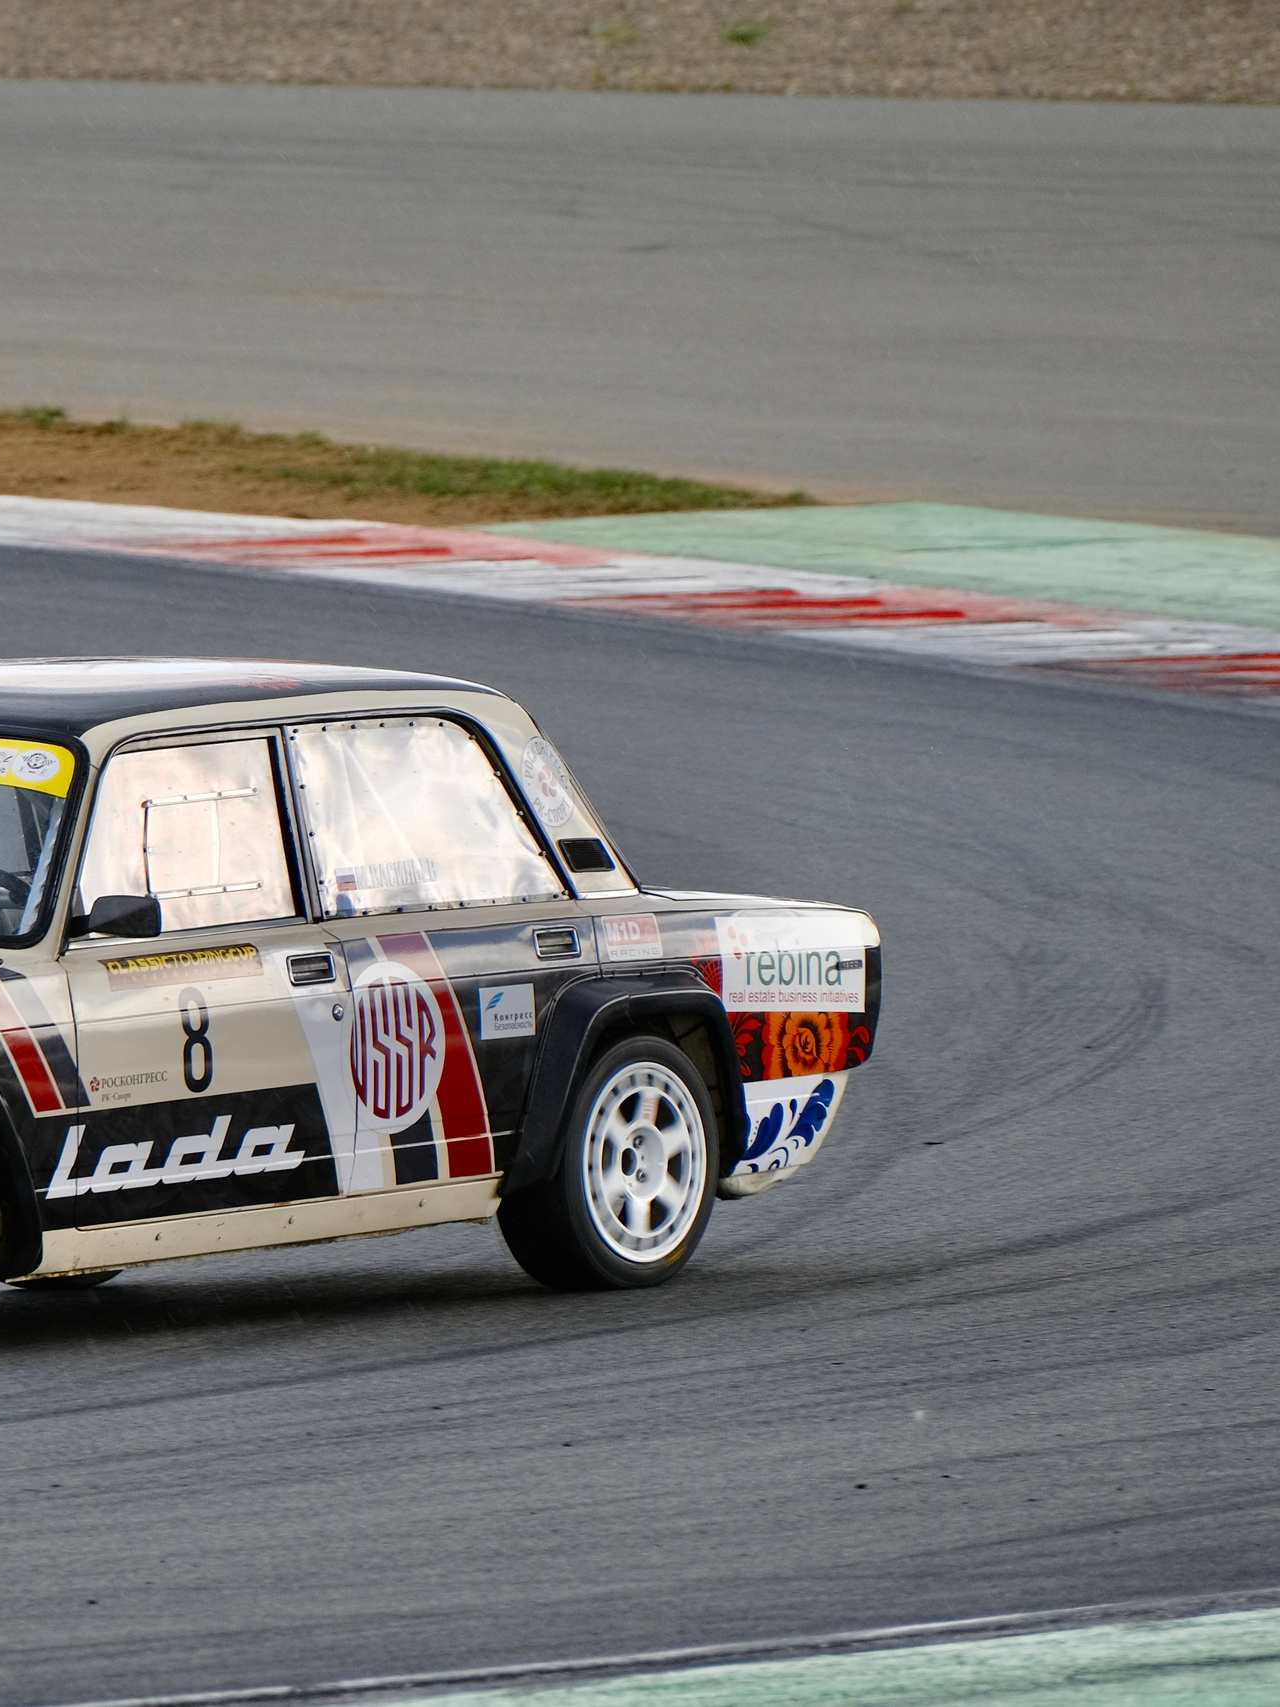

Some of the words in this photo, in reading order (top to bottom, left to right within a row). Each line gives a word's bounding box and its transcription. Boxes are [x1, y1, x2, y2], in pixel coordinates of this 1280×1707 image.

[610, 947, 660, 957] RACING
[744, 939, 842, 986] rebina
[728, 989, 747, 1003] real
[748, 990, 776, 1003] estate
[778, 989, 818, 1003] business
[820, 989, 859, 1003] initiatives
[494, 1012, 533, 1022] Конгресс
[494, 1021, 533, 1031] Безопасность
[178, 987, 213, 1093] 8
[350, 976, 437, 1120] USSR
[101, 1070, 168, 1089] РОСКОНГРЕСС
[45, 1114, 306, 1200] Lada
